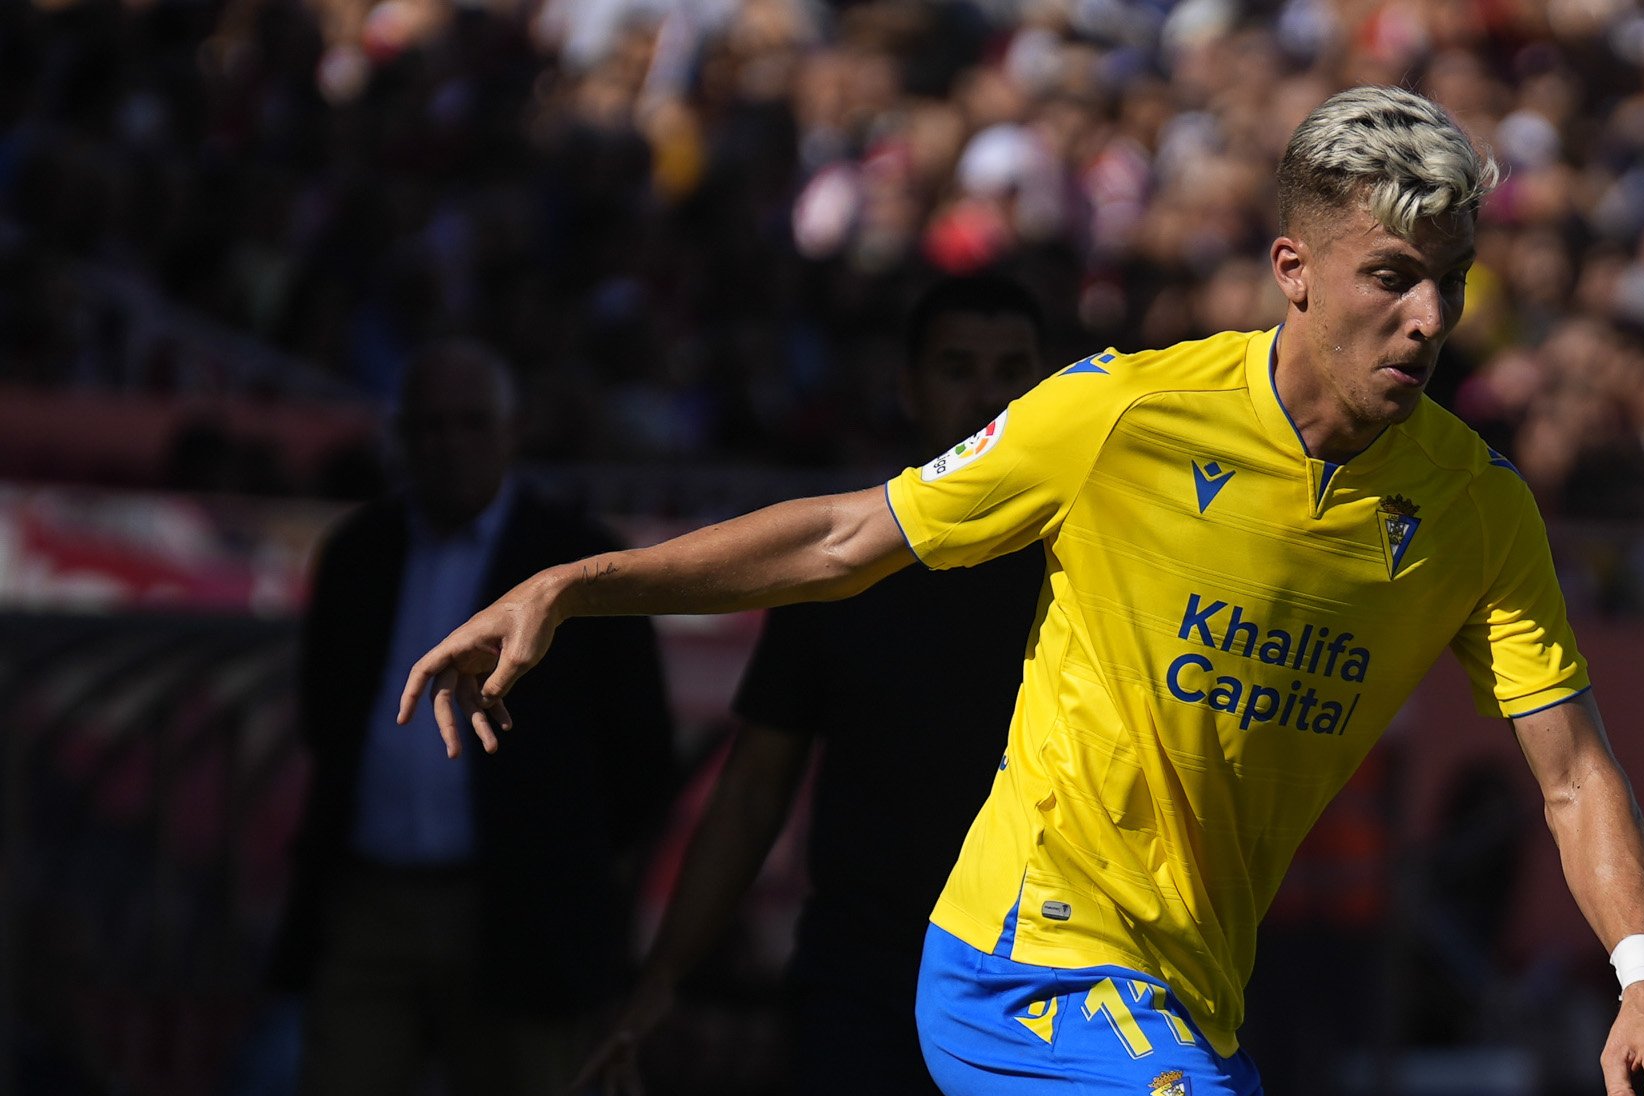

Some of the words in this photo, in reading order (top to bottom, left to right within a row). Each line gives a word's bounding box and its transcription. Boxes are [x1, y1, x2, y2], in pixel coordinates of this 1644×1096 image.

[1177, 593, 1371, 683] Khalifa
[1166, 653, 1361, 736] Capital
[1080, 976, 1197, 1061] 11
